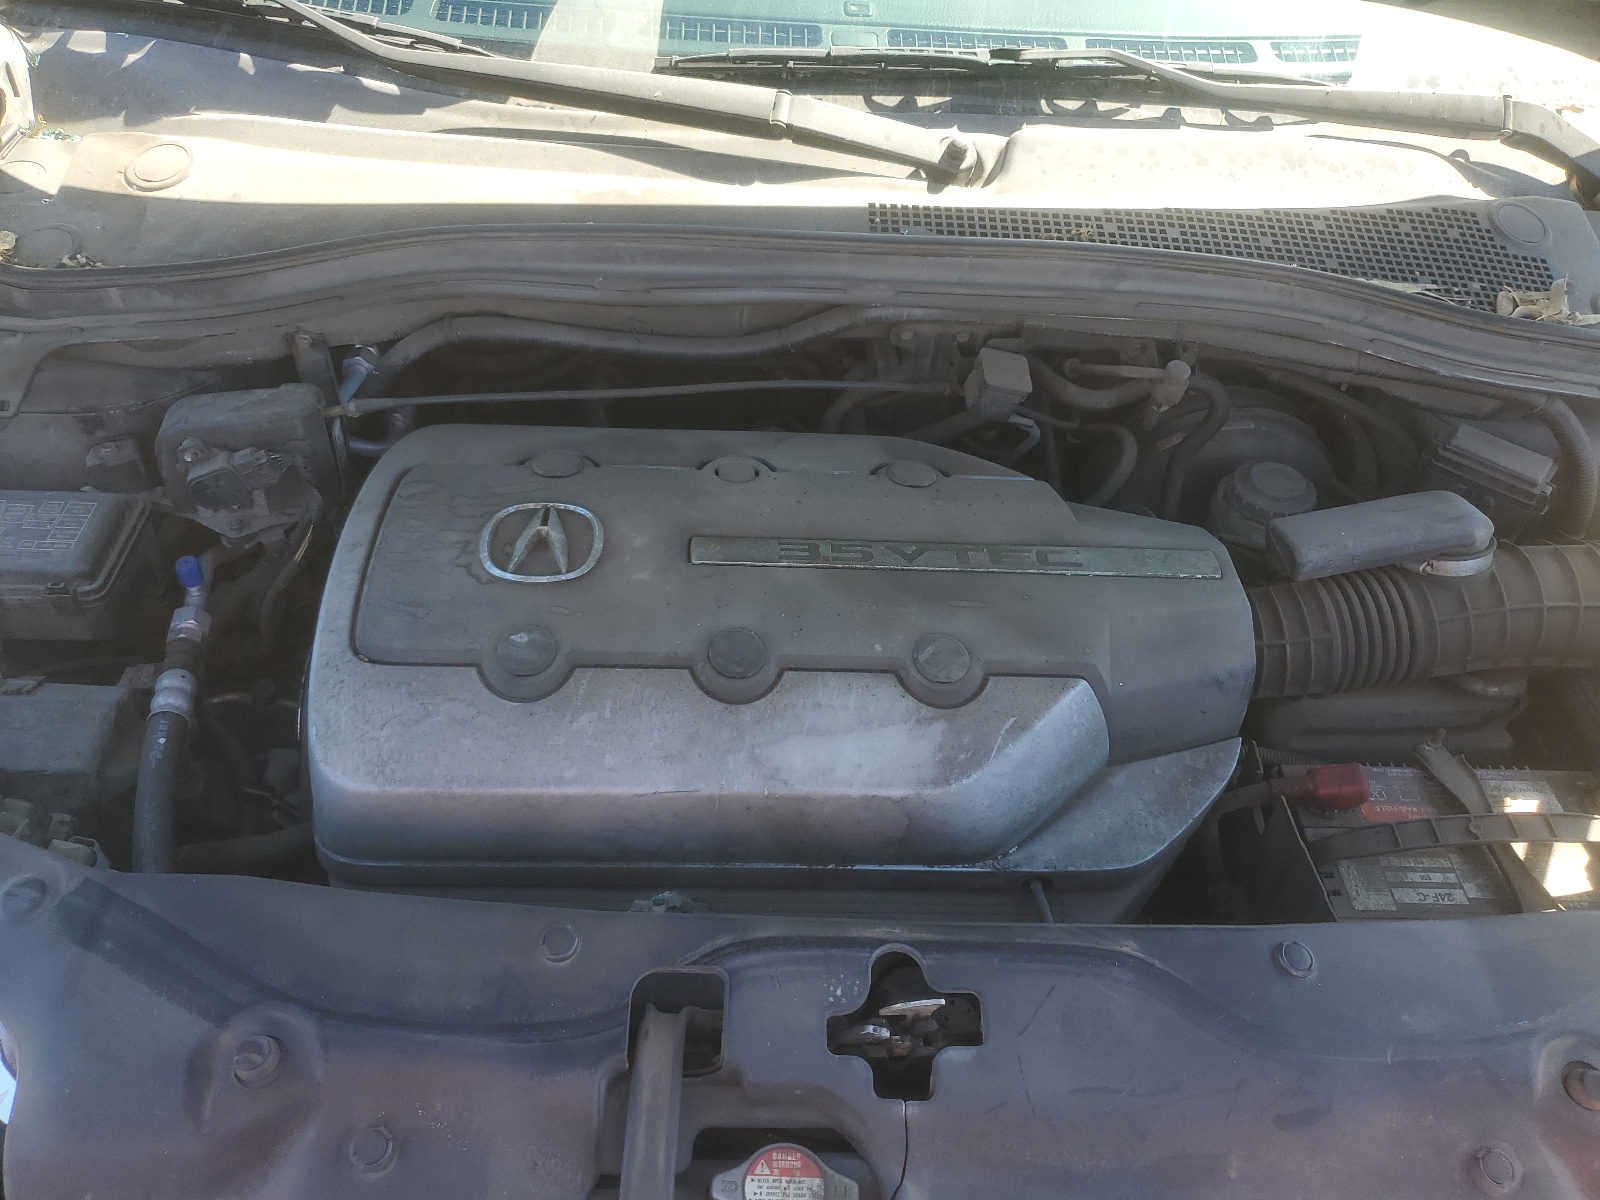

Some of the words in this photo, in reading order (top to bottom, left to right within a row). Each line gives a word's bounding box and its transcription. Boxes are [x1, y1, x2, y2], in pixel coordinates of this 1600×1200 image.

[1416, 892, 1456, 903] 24F-C
[772, 1152, 802, 1161] DANGER
[772, 1160, 802, 1168] WARNING
